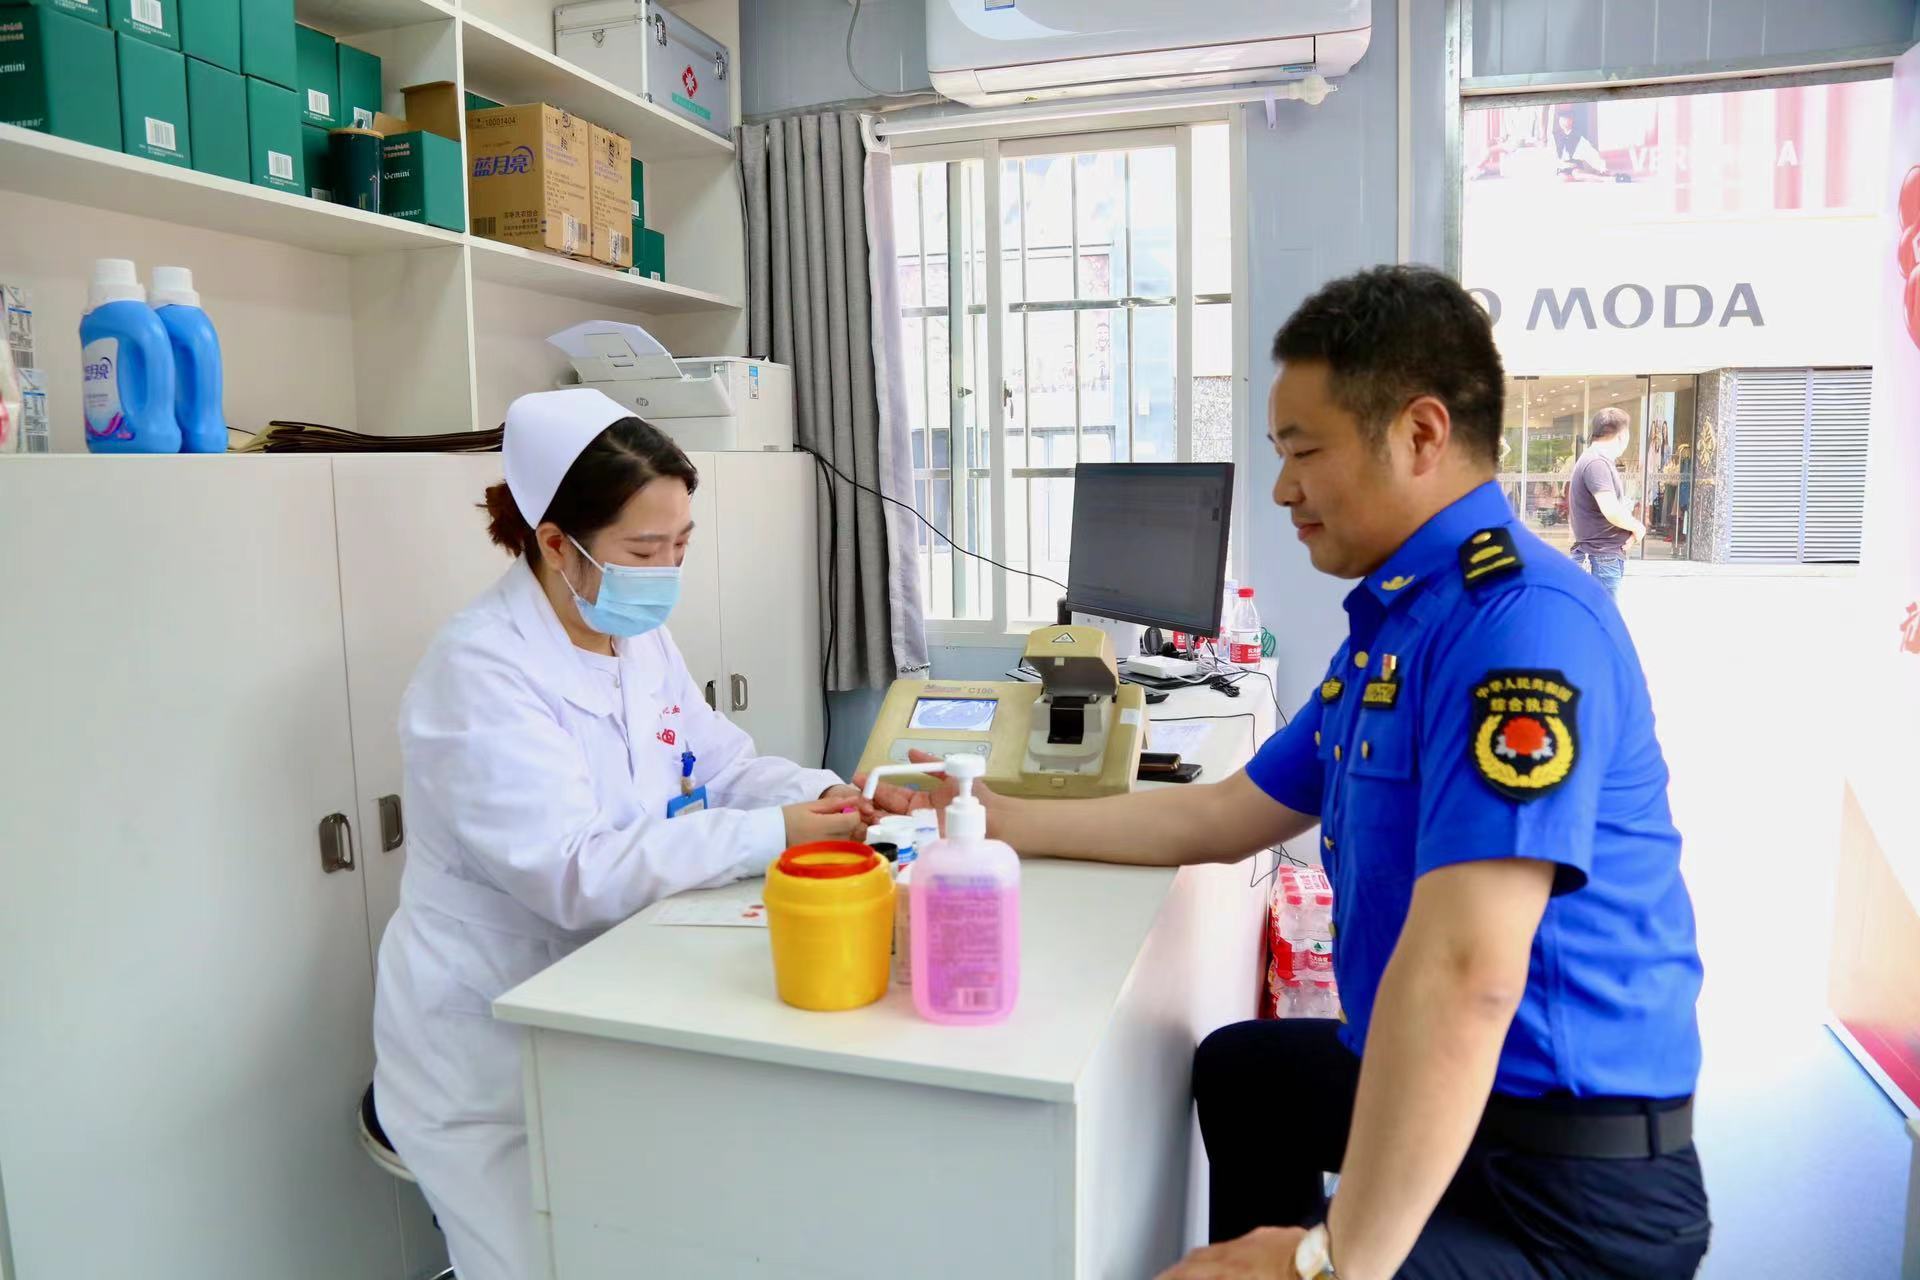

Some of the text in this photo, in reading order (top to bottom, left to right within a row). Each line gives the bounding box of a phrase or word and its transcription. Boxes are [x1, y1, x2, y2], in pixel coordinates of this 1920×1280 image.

[0, 60, 26, 74] emini
[472, 148, 533, 178] 蓝月亮
[1526, 282, 1766, 331] MODA
